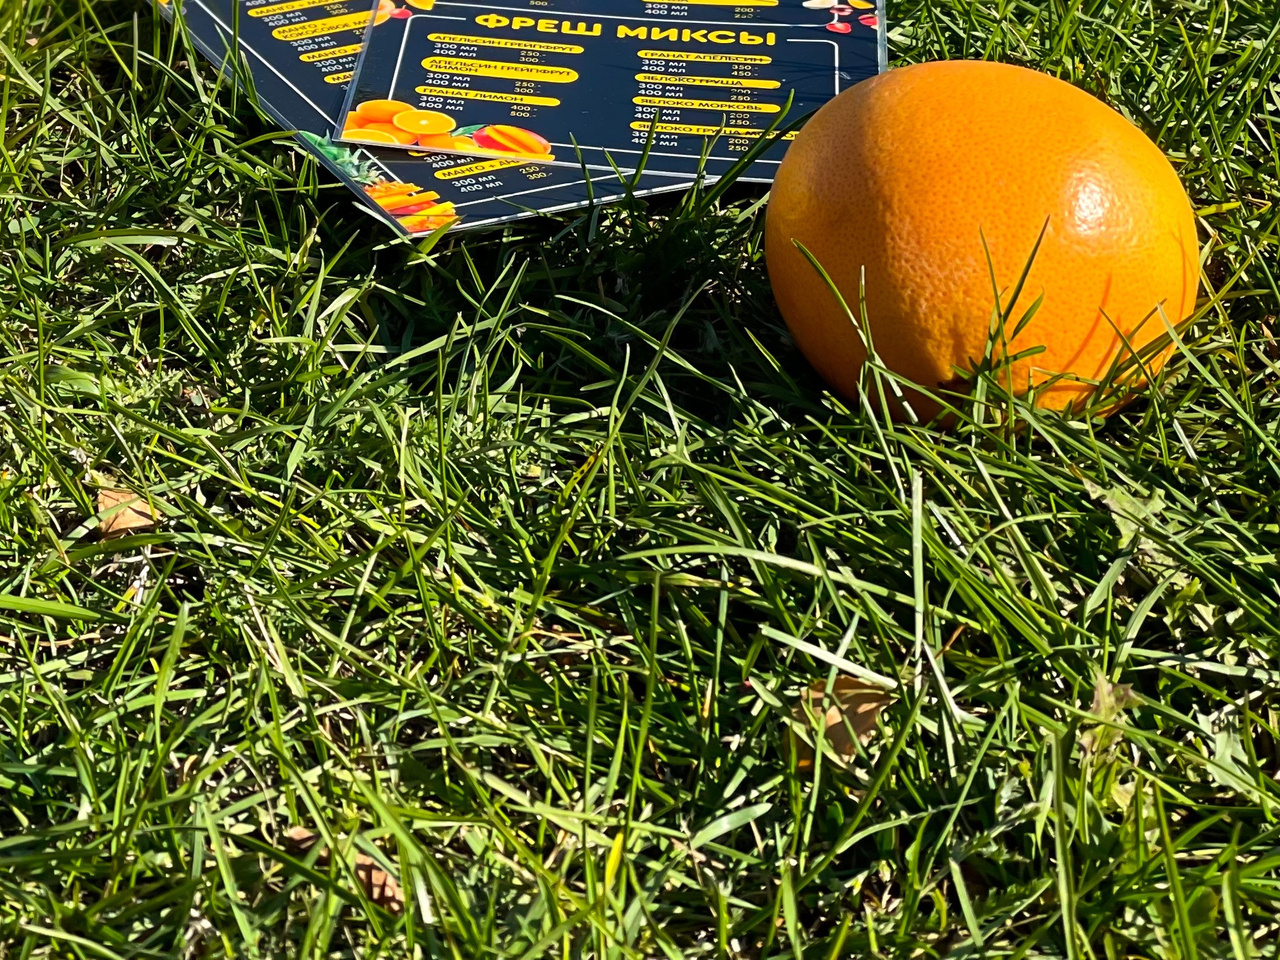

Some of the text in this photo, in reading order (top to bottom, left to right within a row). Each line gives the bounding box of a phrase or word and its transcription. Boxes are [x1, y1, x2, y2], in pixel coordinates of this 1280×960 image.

[255, 4, 294, 15] МАНГО
[262, 14, 282, 22] 300
[278, 23, 318, 34] МАНГО
[283, 22, 350, 39] КОКОСОВОЕ
[475, 14, 776, 46] ФРЕШ МИКСЫ
[297, 44, 318, 52] 400
[433, 35, 575, 52] АПЕЛЬСИН ГРЕЙПФРУТ
[307, 49, 348, 60] МАНГО
[694, 54, 763, 63] АПЕЛЬСИН
[321, 64, 342, 72] 400
[429, 59, 571, 76] АПЕЛЬСИН ГРЕЙПФРУТ
[429, 64, 478, 72] ЛИМОН
[642, 75, 696, 83] ЯБЛОКО
[422, 88, 523, 102] ГРАНАТ ЛИМОН
[640, 98, 762, 111] ЯБЛОКО МОРКОВЬ
[442, 166, 486, 177] МАНГО
[452, 179, 476, 187] 300
[460, 184, 483, 192] 400
